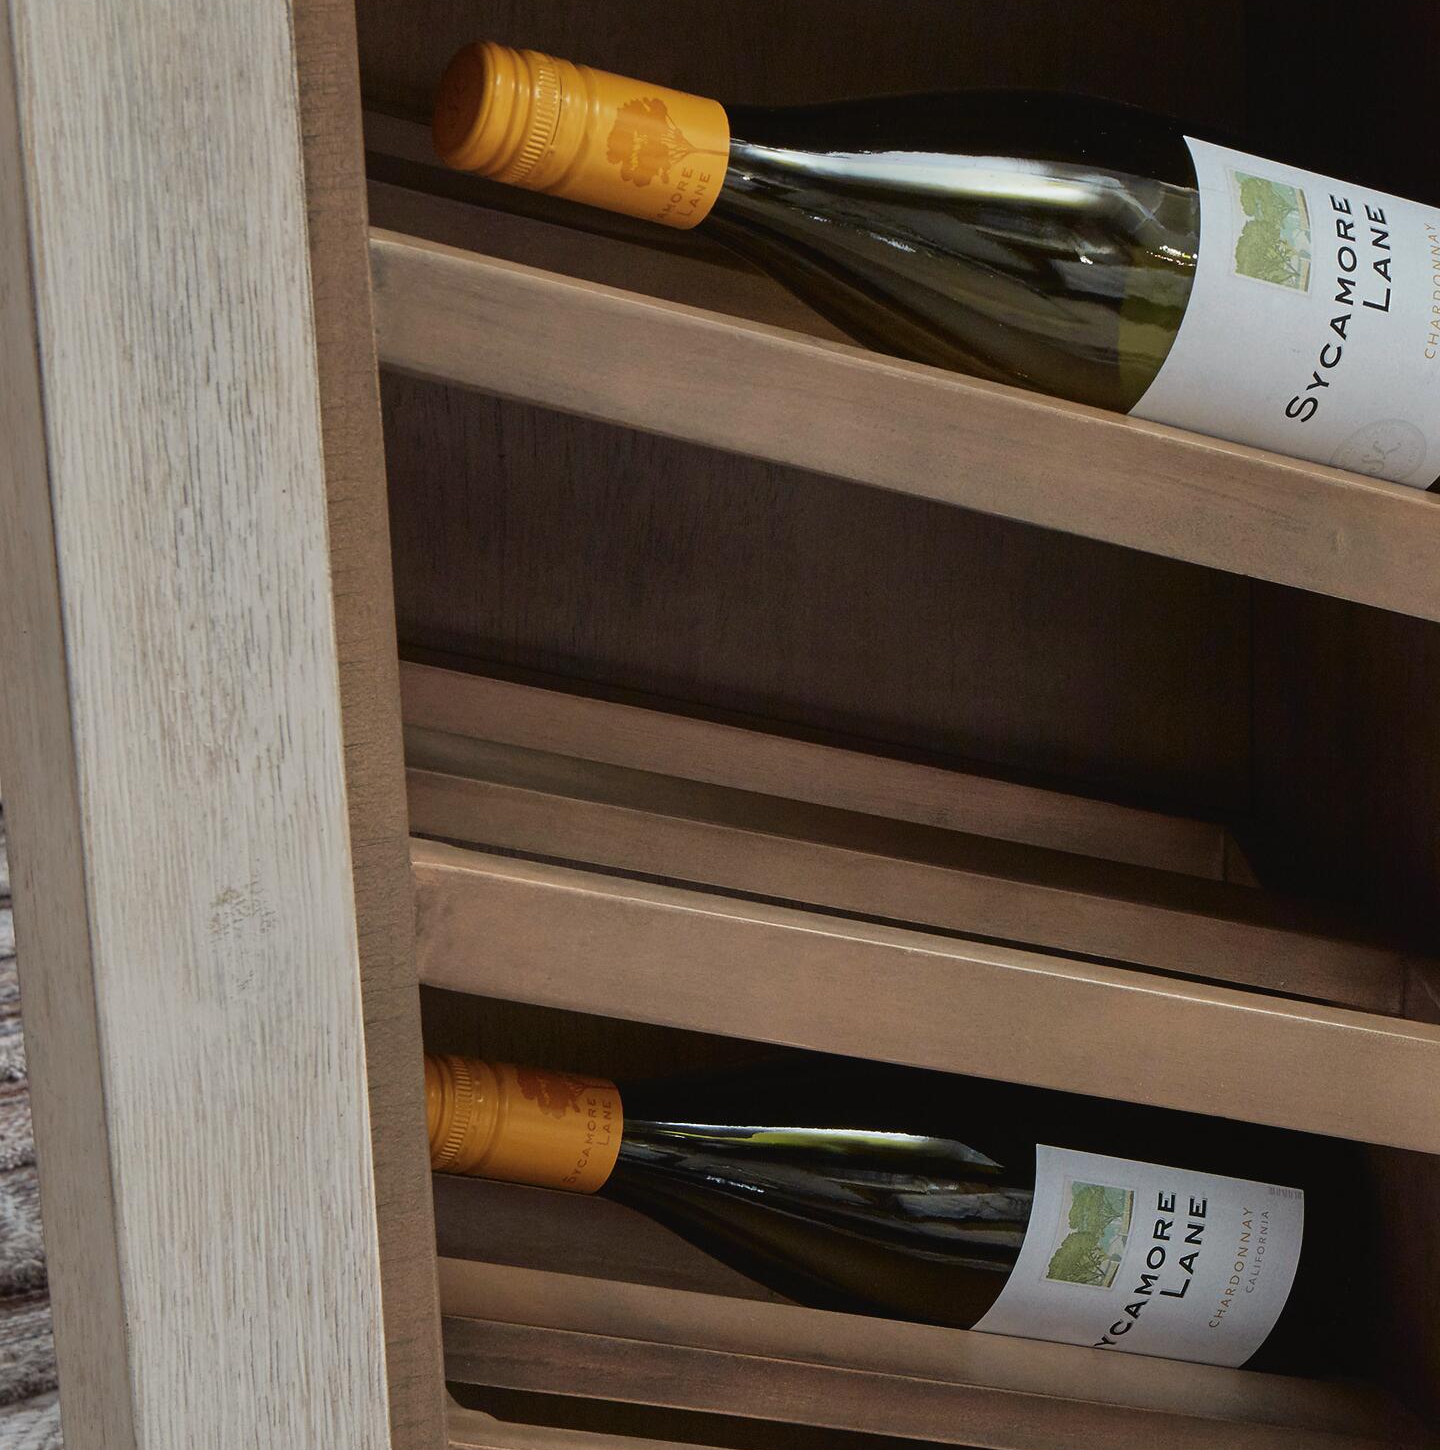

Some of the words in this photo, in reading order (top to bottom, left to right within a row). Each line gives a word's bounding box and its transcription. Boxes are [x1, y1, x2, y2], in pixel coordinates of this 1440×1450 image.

[676, 172, 712, 217] LANE
[1285, 193, 1359, 423] SYCAMORE
[1362, 203, 1391, 313] LANE
[562, 1097, 597, 1184] SYCAMORE
[596, 1100, 612, 1146] LANE
[1093, 1190, 1177, 1349] YCAMORE
[1159, 1196, 1208, 1299] LANE
[1208, 1206, 1254, 1329] CHARDONNAY
[1245, 1209, 1270, 1294] CALIFORNIA
